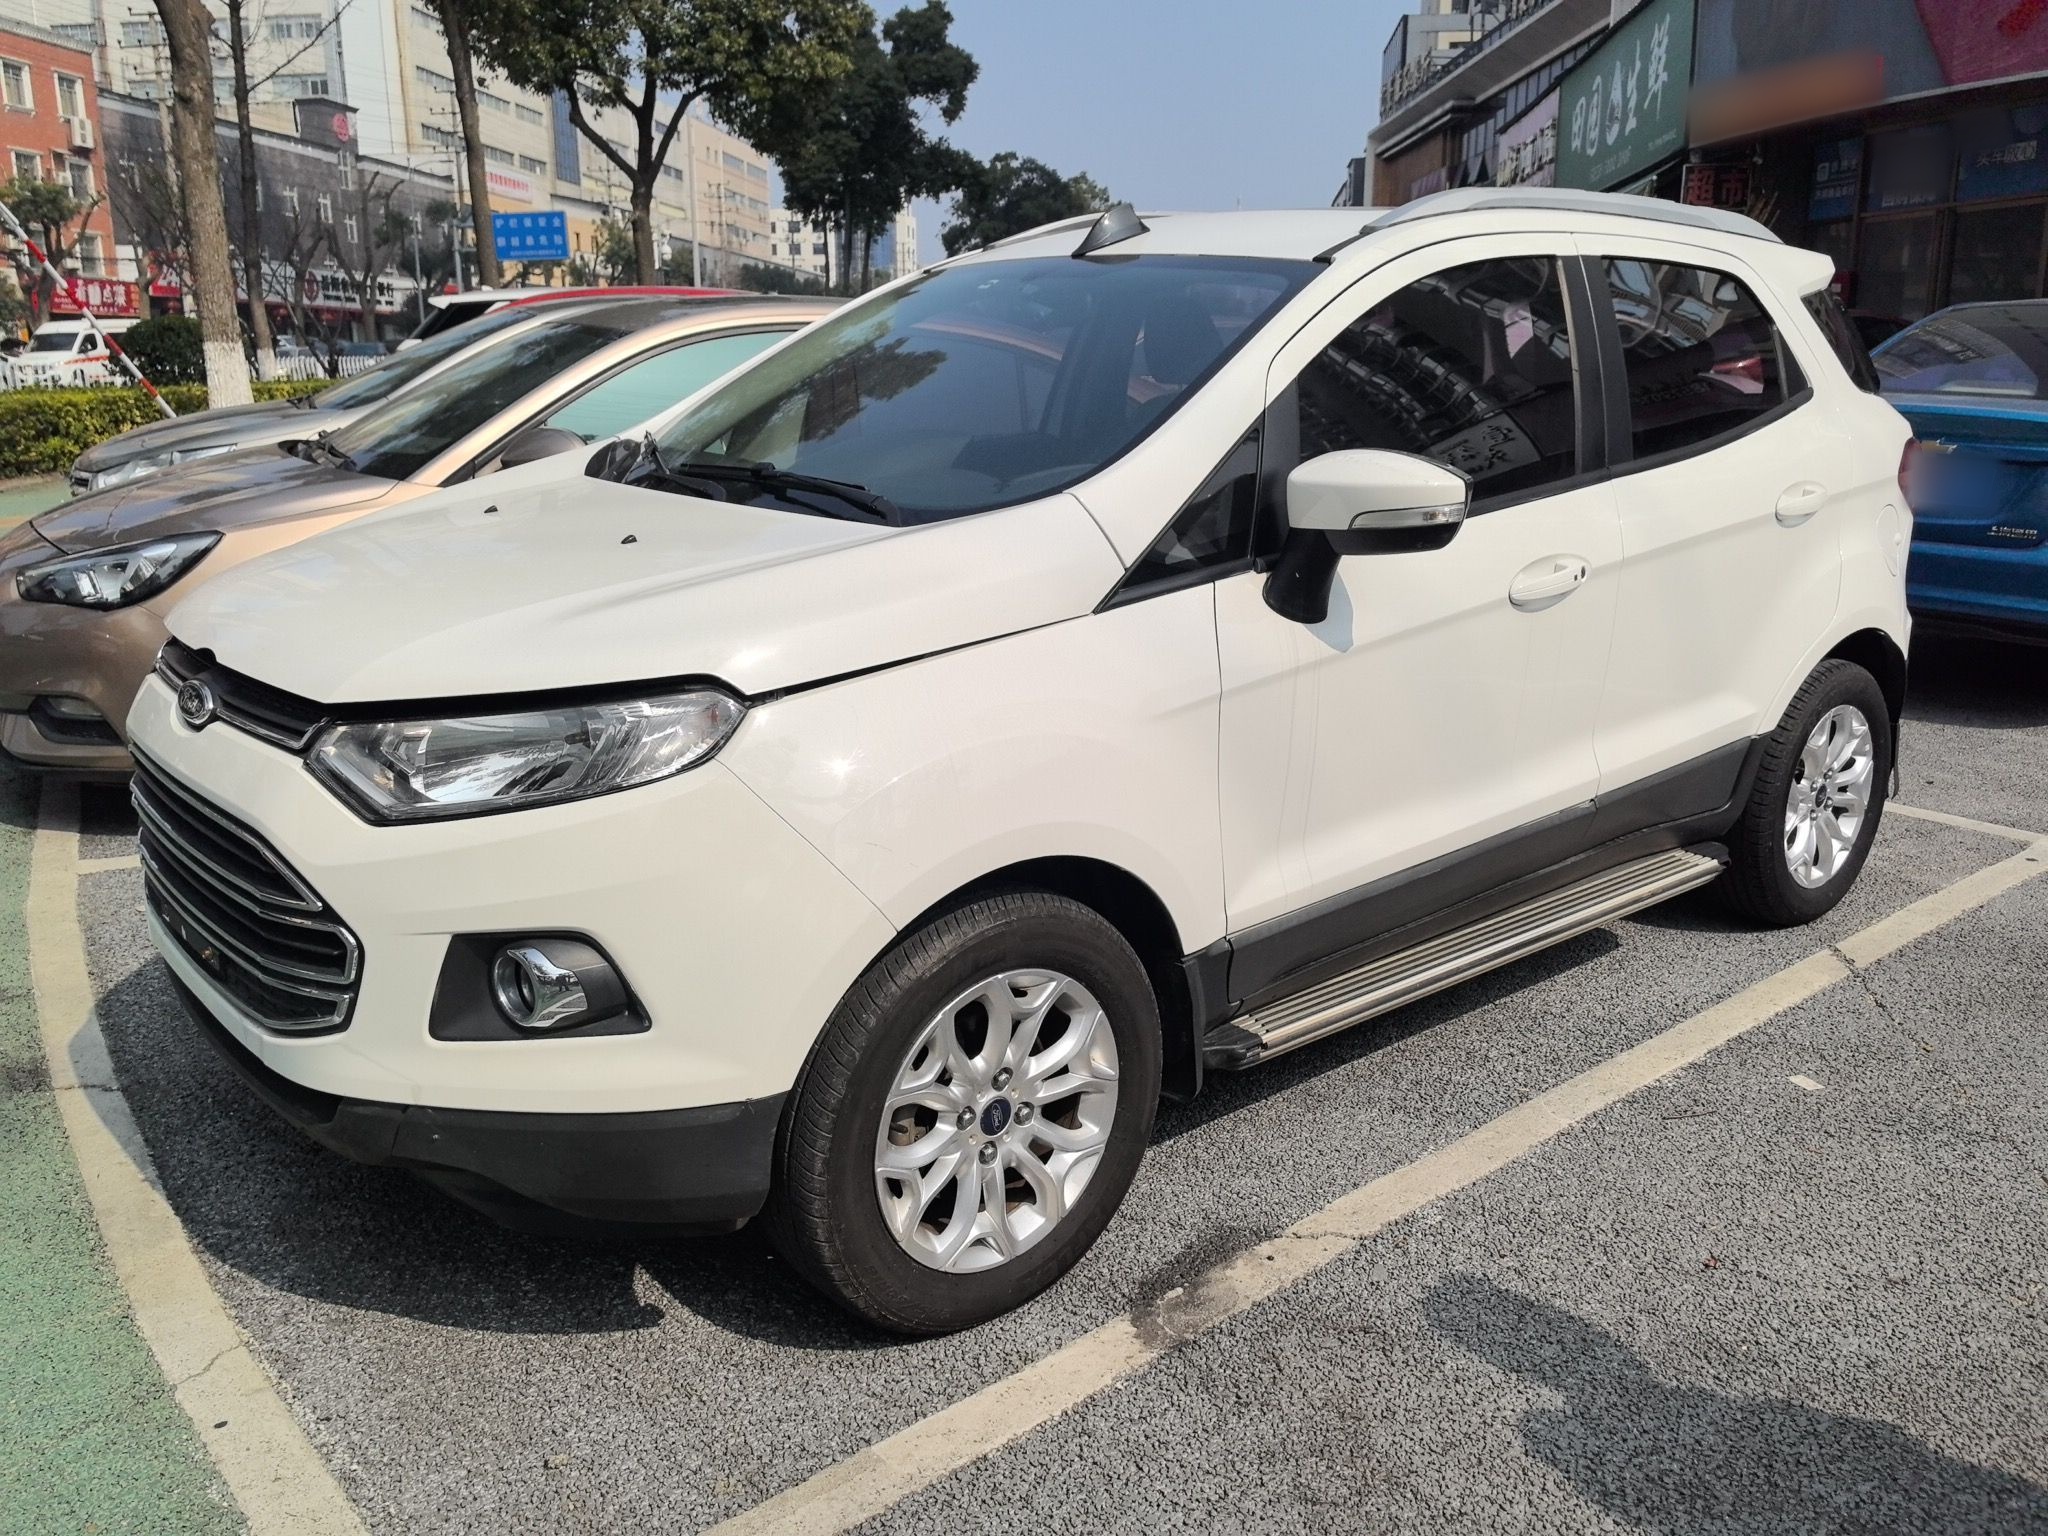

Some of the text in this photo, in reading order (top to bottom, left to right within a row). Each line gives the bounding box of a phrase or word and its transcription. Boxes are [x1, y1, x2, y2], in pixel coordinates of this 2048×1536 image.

[1687, 168, 1746, 206] 超市
[181, 687, 202, 714] Ford
[992, 1109, 1001, 1127] Ford
